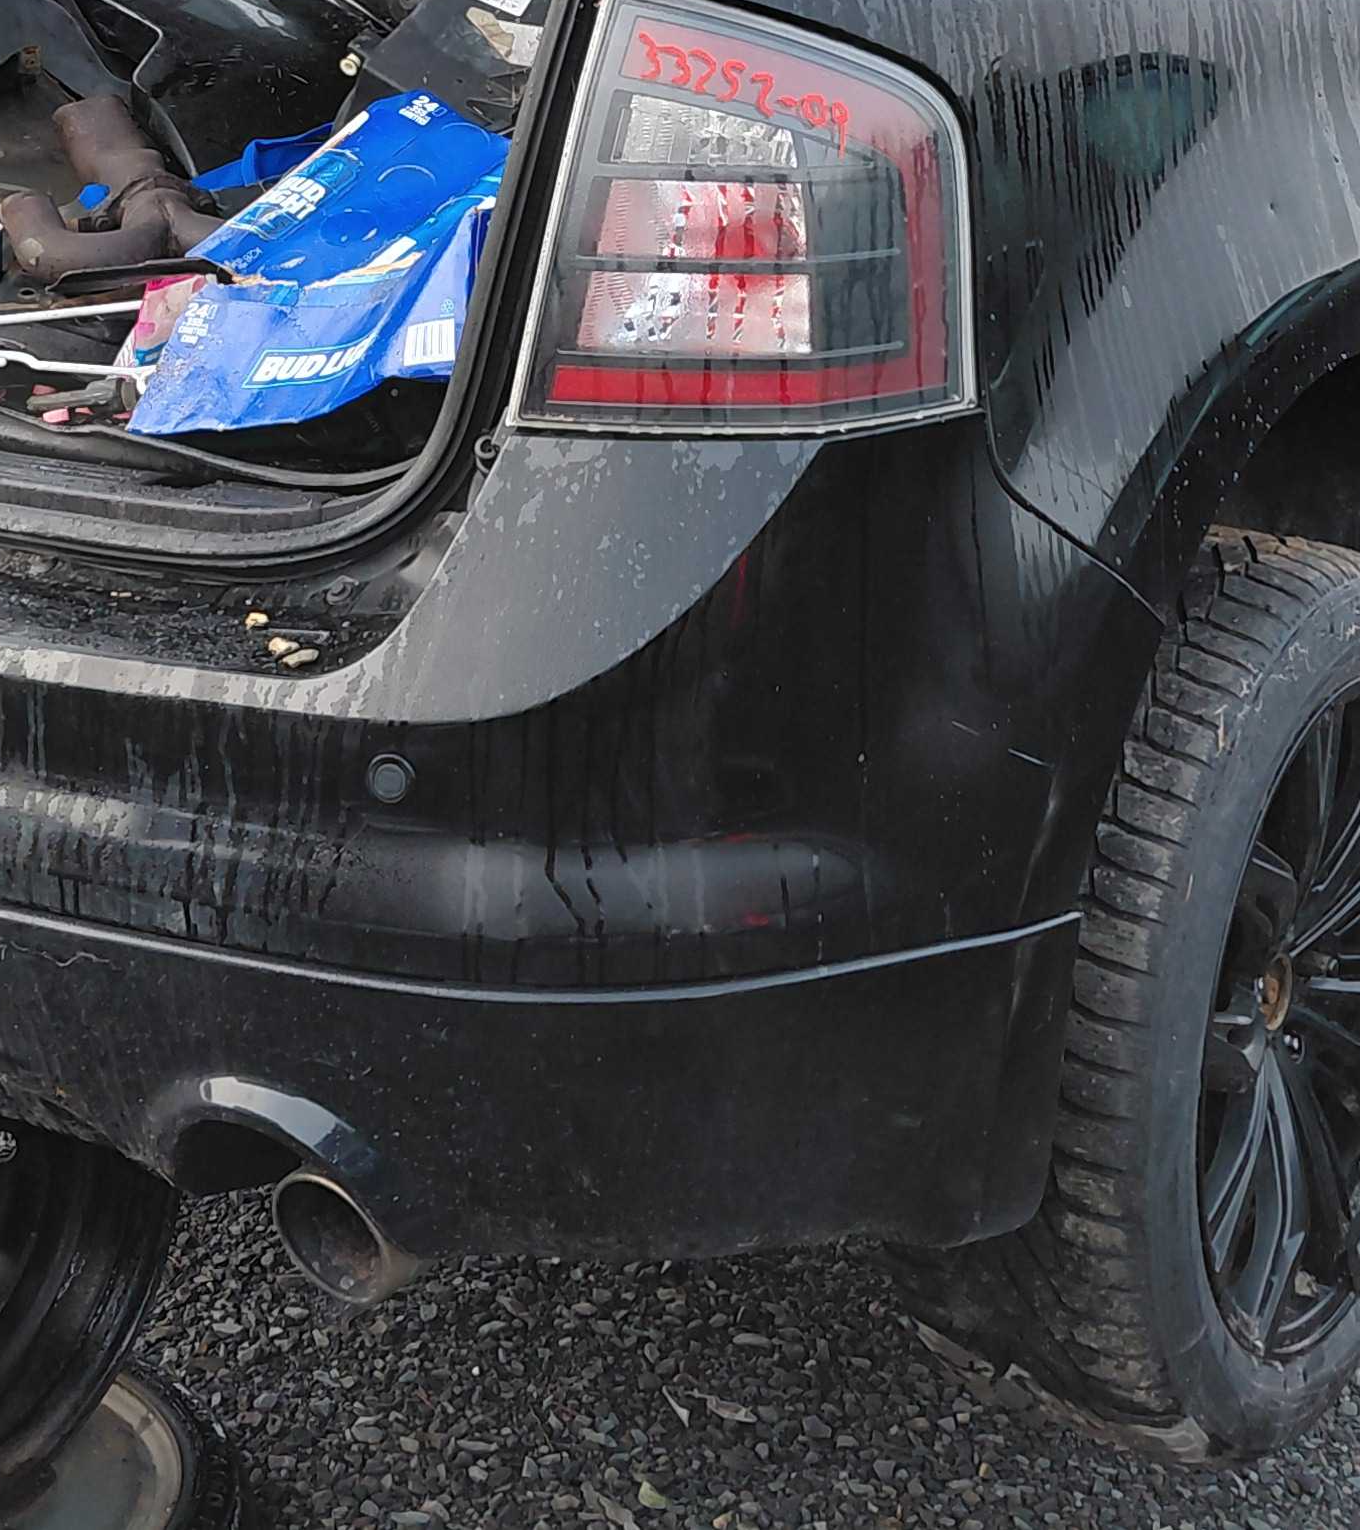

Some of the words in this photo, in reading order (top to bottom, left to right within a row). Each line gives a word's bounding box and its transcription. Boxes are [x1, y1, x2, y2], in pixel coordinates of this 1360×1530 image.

[412, 95, 440, 112] 24
[638, 33, 850, 162] 33252-09
[185, 302, 210, 318] 24
[252, 355, 327, 381] BUD
